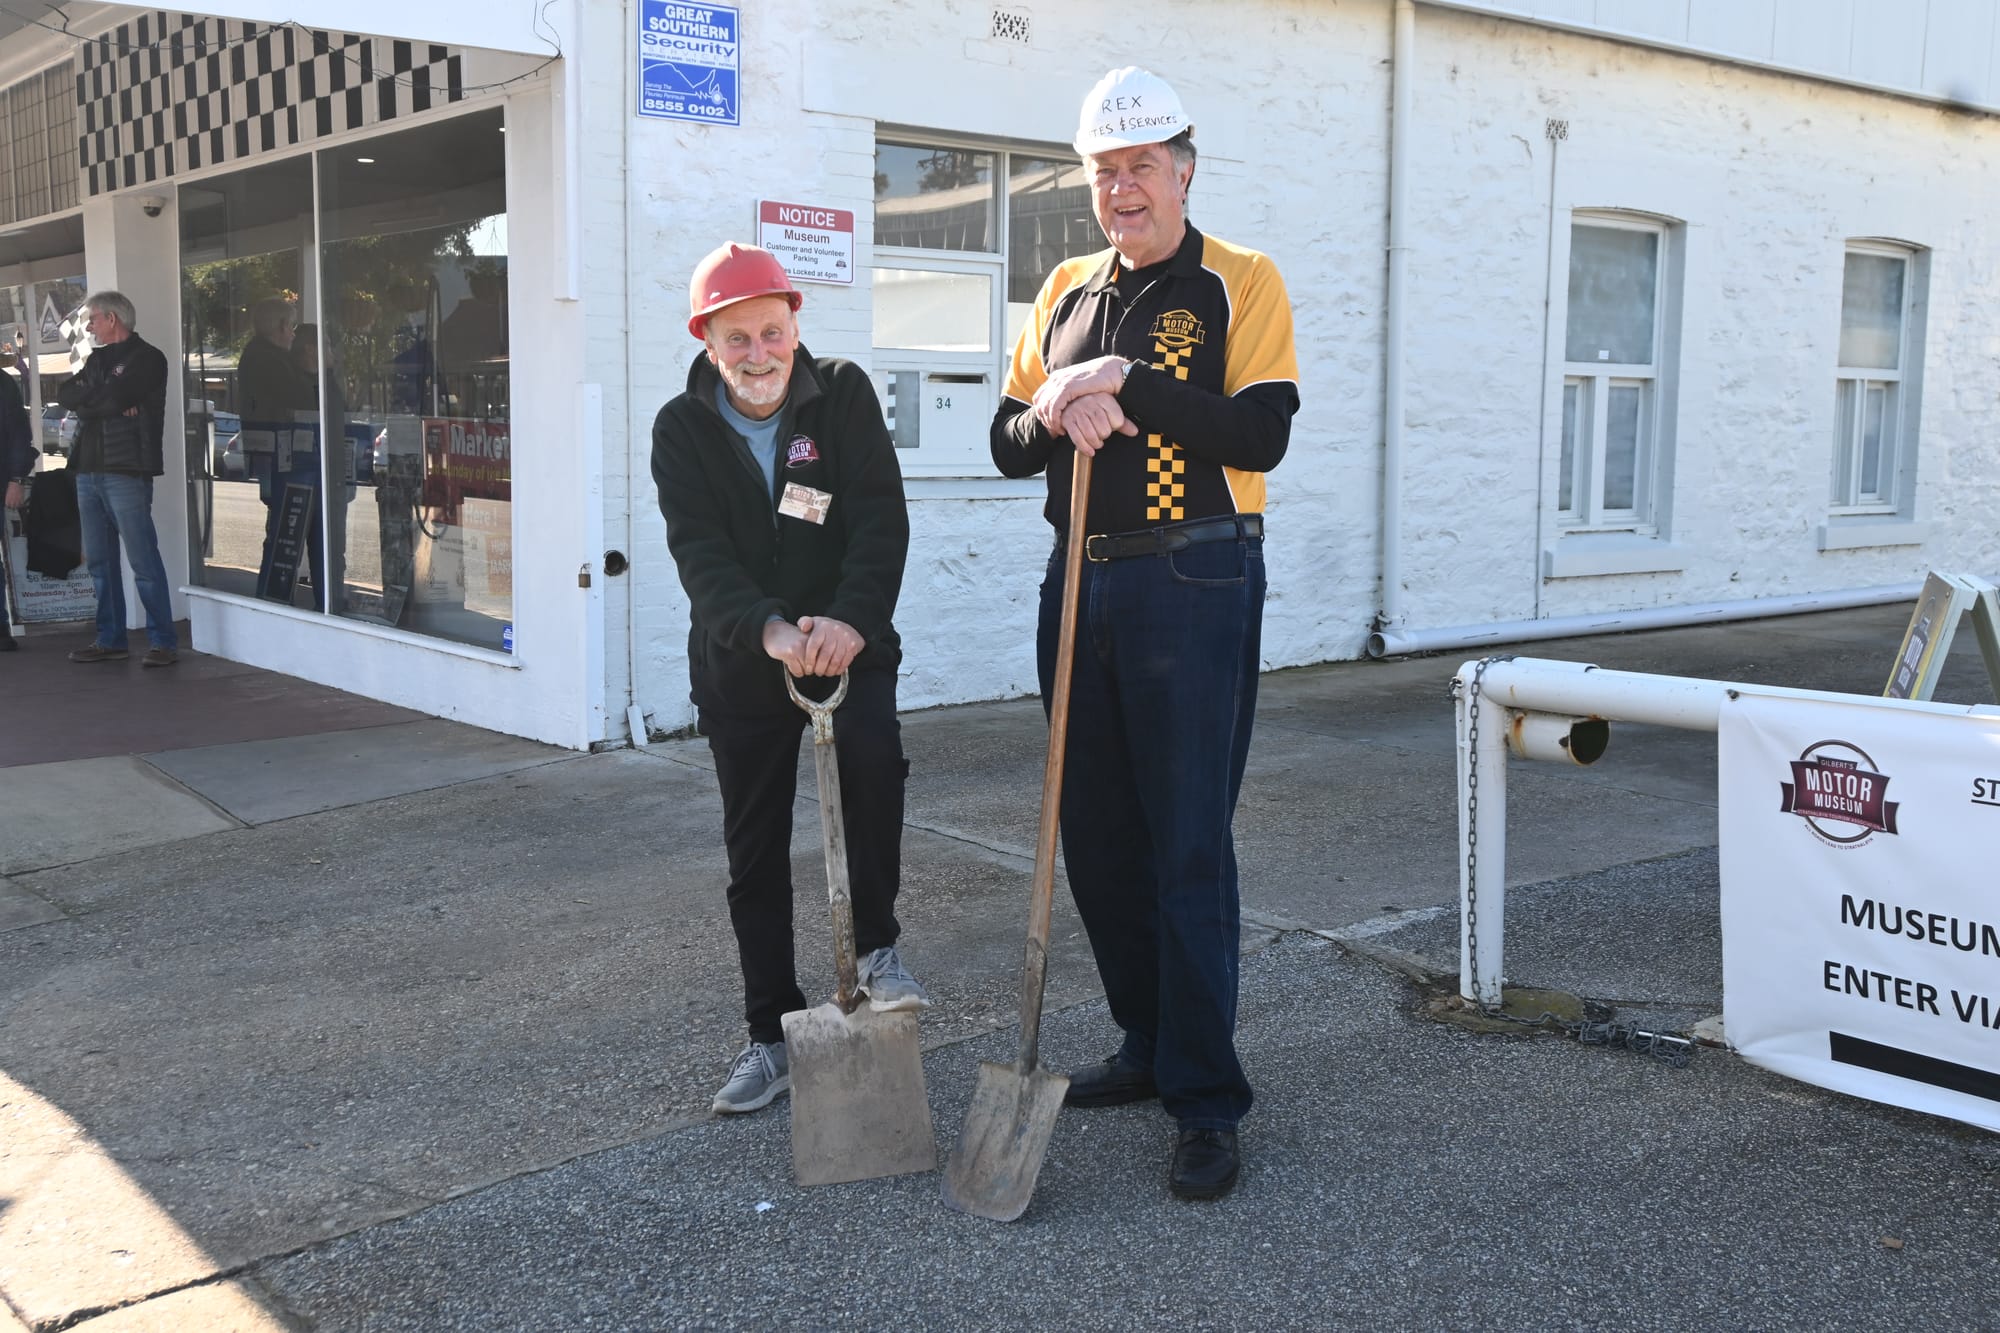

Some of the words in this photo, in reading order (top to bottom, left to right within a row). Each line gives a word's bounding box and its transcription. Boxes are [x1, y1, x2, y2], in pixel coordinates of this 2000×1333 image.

[665, 5, 713, 24] GREAT
[649, 16, 729, 40] SOUTHERN
[643, 33, 735, 57] Security
[645, 99, 684, 112] 8555
[688, 104, 725, 117] 0102
[1101, 96, 1142, 114] REX
[1128, 115, 1178, 130] SERVICES
[779, 206, 836, 227] NOTICE
[784, 229, 830, 244] Museum
[766, 242, 798, 252] Customer
[799, 246, 812, 254] and
[813, 247, 845, 257] Volunteer
[793, 254, 819, 265] Parking
[793, 268, 816, 276] Locked
[824, 271, 838, 279] 4pm
[1163, 319, 1195, 331] MOTOR
[936, 397, 952, 409] 34
[1821, 759, 1855, 770] GILBERT'S
[1805, 767, 1873, 802] MOTOR
[1814, 793, 1863, 815] MUSEUM
[1824, 960, 1940, 1016] ENTER
